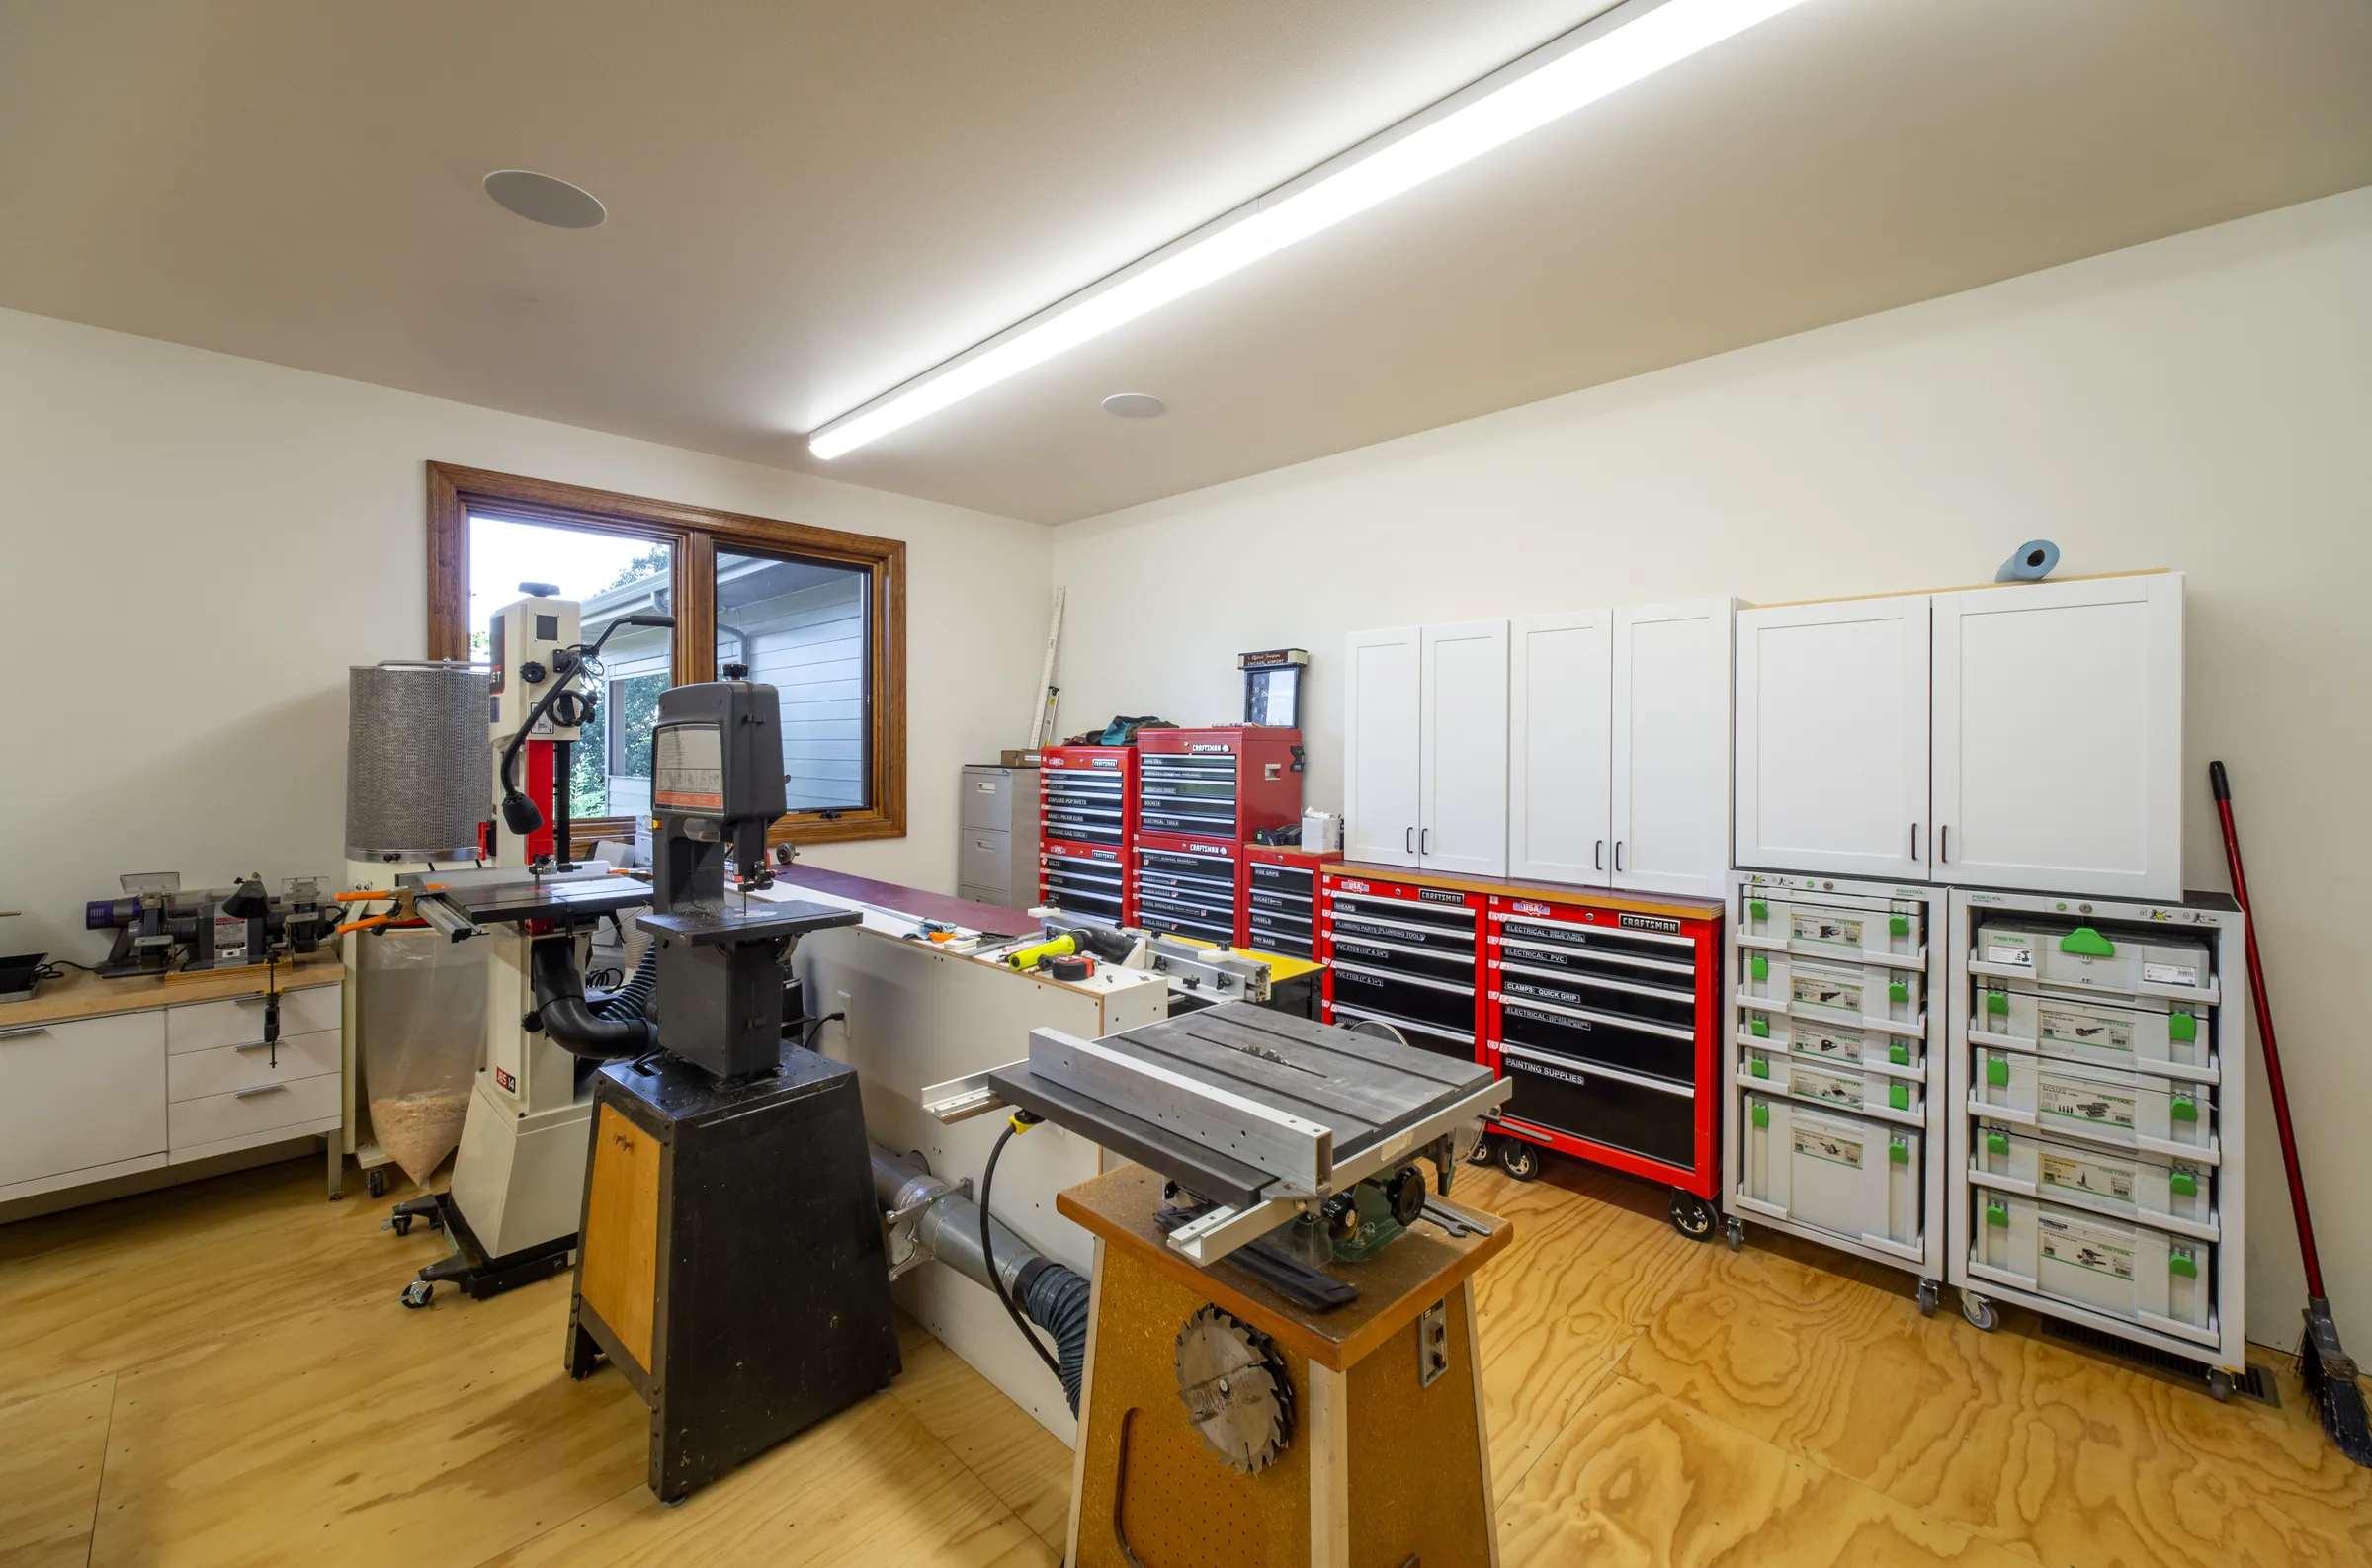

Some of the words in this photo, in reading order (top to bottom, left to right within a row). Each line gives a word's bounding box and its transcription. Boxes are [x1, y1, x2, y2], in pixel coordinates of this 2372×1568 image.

[1190, 844, 1219, 854] CRAFTSMAN
[1421, 891, 1462, 903] CRAFTSMAN
[1523, 903, 1540, 912] USA
[1253, 916, 1271, 925] CHISELS
[1335, 921, 1360, 930] PLUMBING
[1622, 917, 1676, 932] CRAFTSMAN
[1506, 924, 1549, 937] ELECTRICAL:
[1506, 949, 1548, 960] ELECTRICAL:
[1506, 983, 1535, 993] CLAMPS:
[1538, 989, 1559, 998] QUICK
[1506, 1007, 1549, 1021] ELECTRICAL:
[1506, 1059, 1542, 1073] PAINTING
[1544, 1068, 1583, 1084] SUPPLIES
[2098, 1094, 2131, 1104] FESTOOL
[2098, 1245, 2131, 1257] FESTOOL
